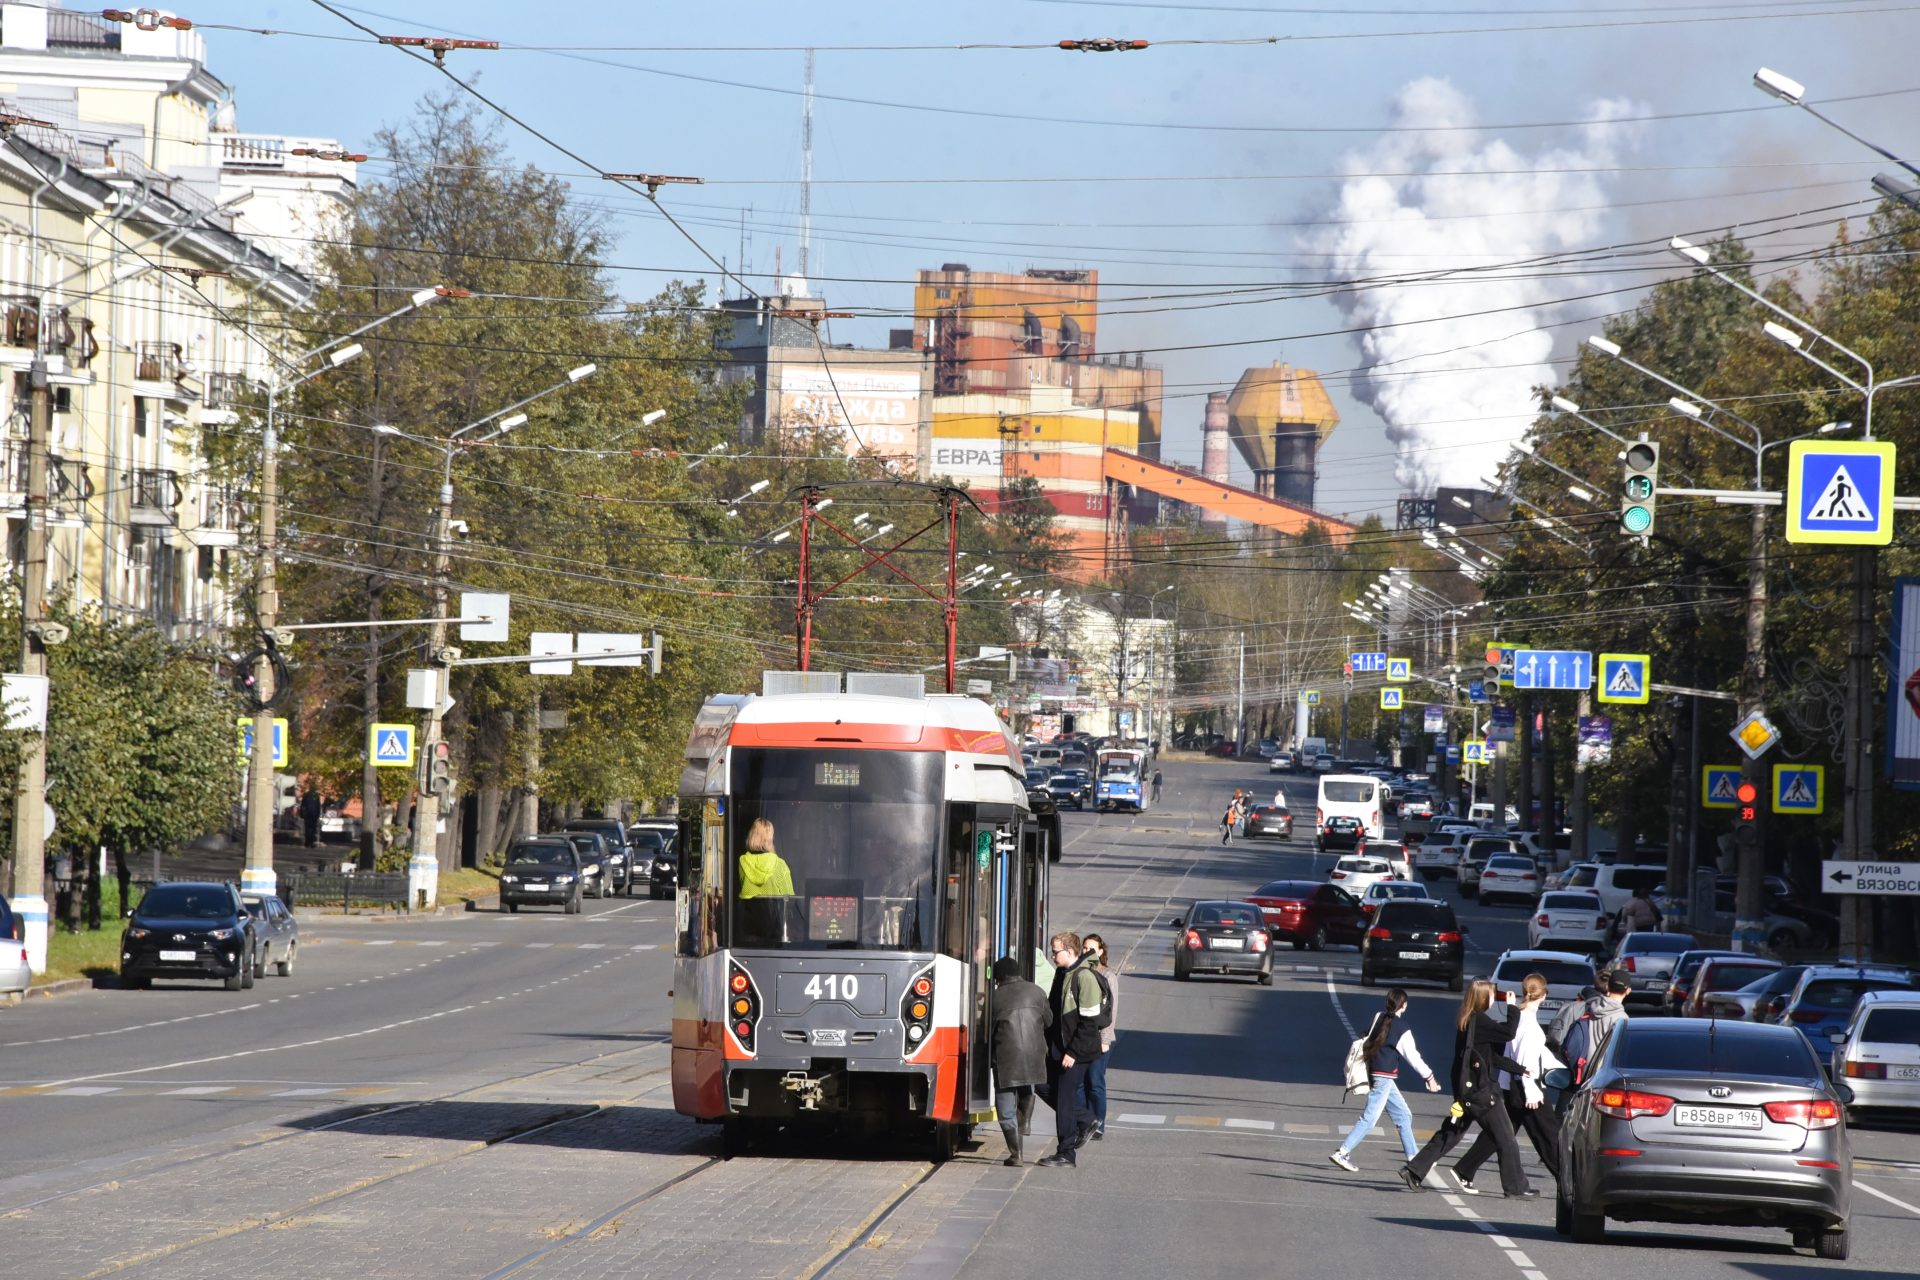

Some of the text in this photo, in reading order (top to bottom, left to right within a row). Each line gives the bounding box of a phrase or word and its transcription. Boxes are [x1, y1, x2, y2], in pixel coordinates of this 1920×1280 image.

[937, 448, 1003, 466] ЕВРАЗ
[1629, 479, 1650, 498] 13
[1742, 807, 1754, 820] 39
[1857, 865, 1901, 876] улица
[1857, 879, 1920, 892] ВЯЗОВС
[804, 974, 858, 1000] 410
[1711, 1088, 1729, 1097] KIA
[1738, 1111, 1758, 1122] 196
